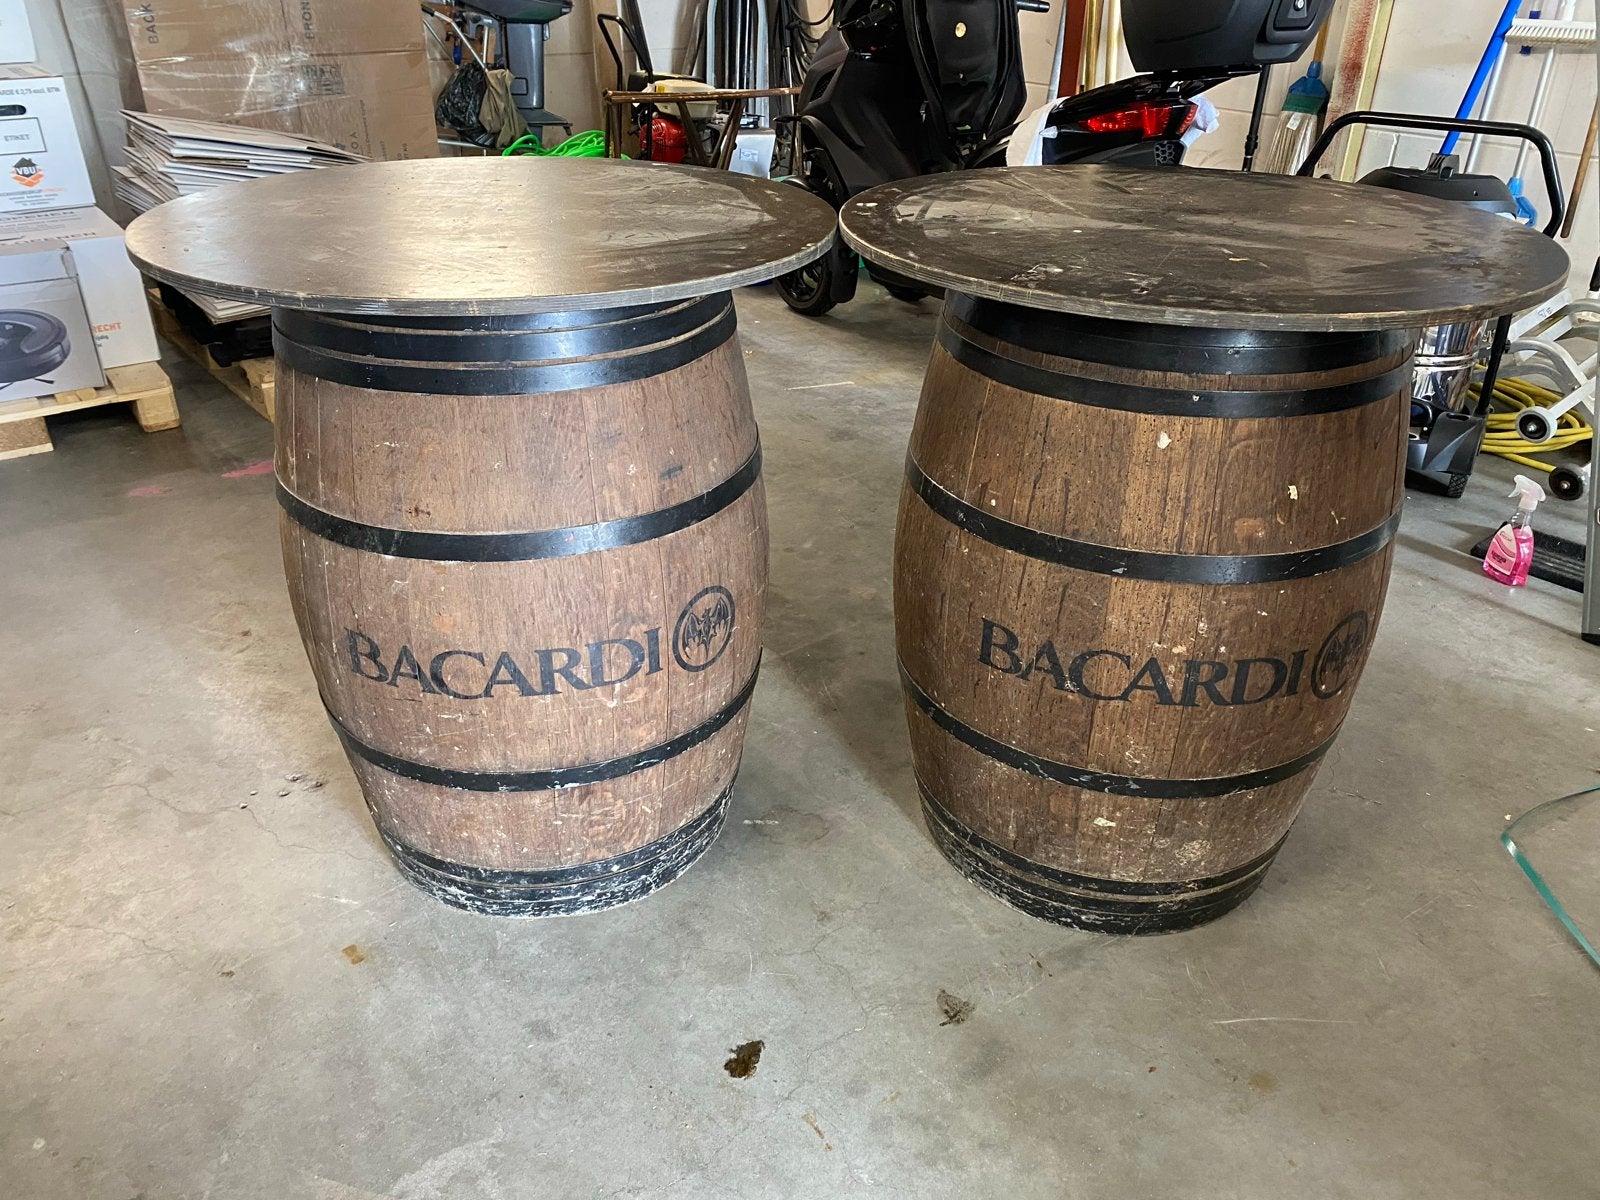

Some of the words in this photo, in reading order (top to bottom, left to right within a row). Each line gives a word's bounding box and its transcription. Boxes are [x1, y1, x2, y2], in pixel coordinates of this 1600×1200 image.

[141, 3, 159, 44] BACK
[16, 166, 37, 176] VBU
[344, 627, 663, 700] BACARDI
[977, 617, 1309, 707] BACARDI
